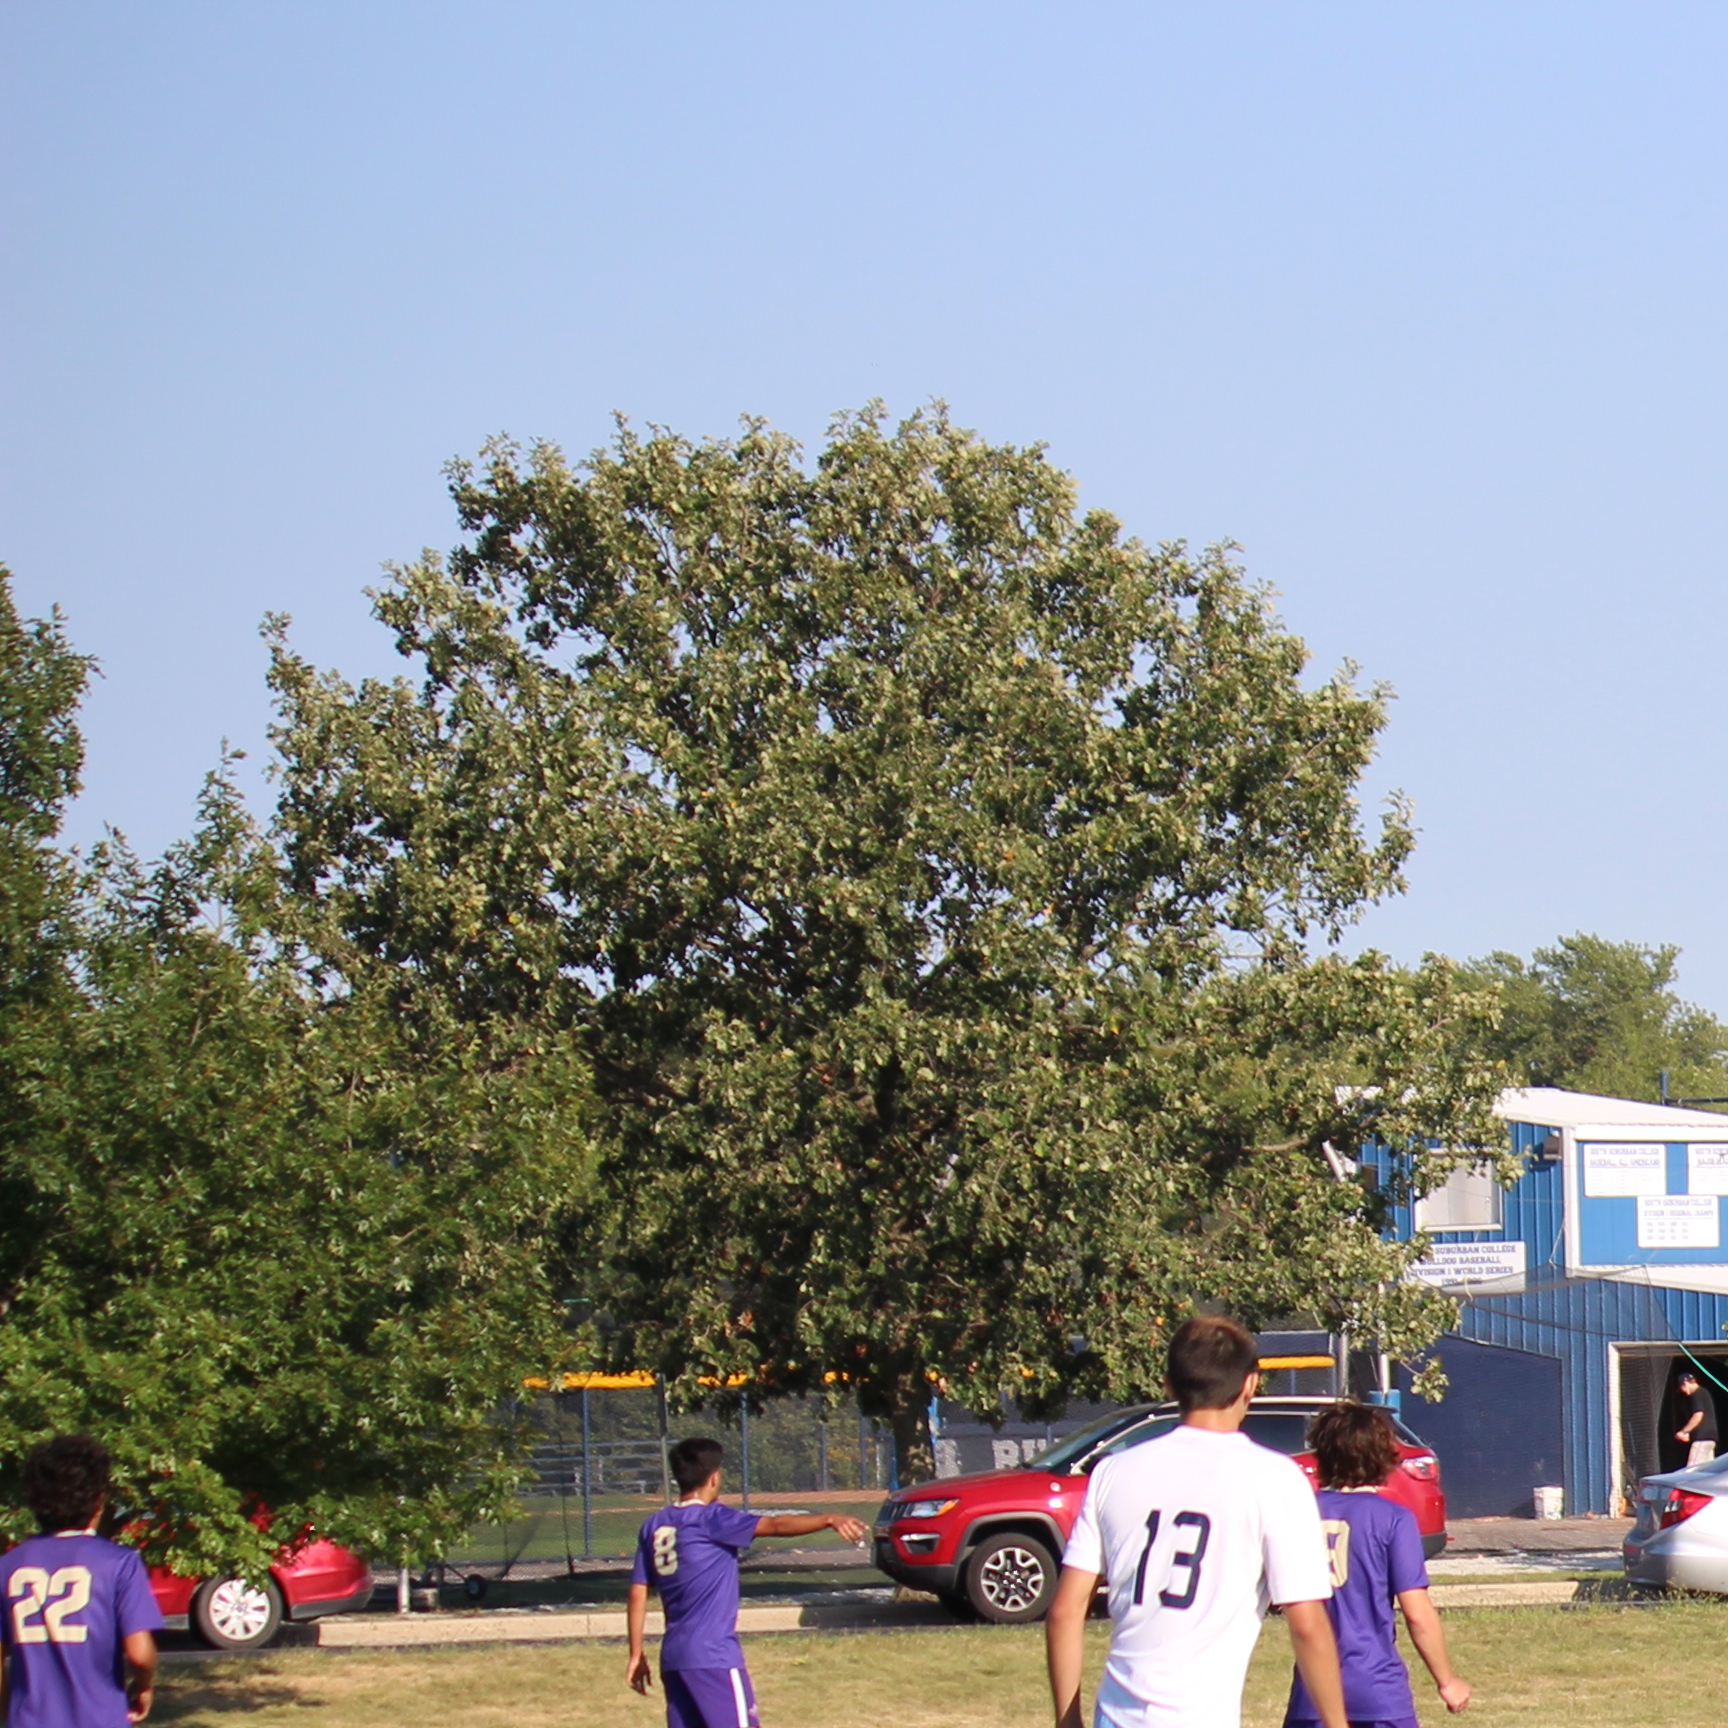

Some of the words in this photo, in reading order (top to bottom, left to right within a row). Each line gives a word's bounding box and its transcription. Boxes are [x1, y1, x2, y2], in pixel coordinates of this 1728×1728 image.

[1434, 1246, 1479, 1255] SUBURBAN
[1481, 1244, 1516, 1254] COLLEGE
[1458, 1255, 1501, 1264] BASEBALL
[1453, 1267, 1484, 1275] WORLD
[1484, 1265, 1514, 1274] SERIES
[653, 1525, 679, 1577] 8
[1132, 1509, 1210, 1609] 13
[8, 1565, 93, 1644] 22
